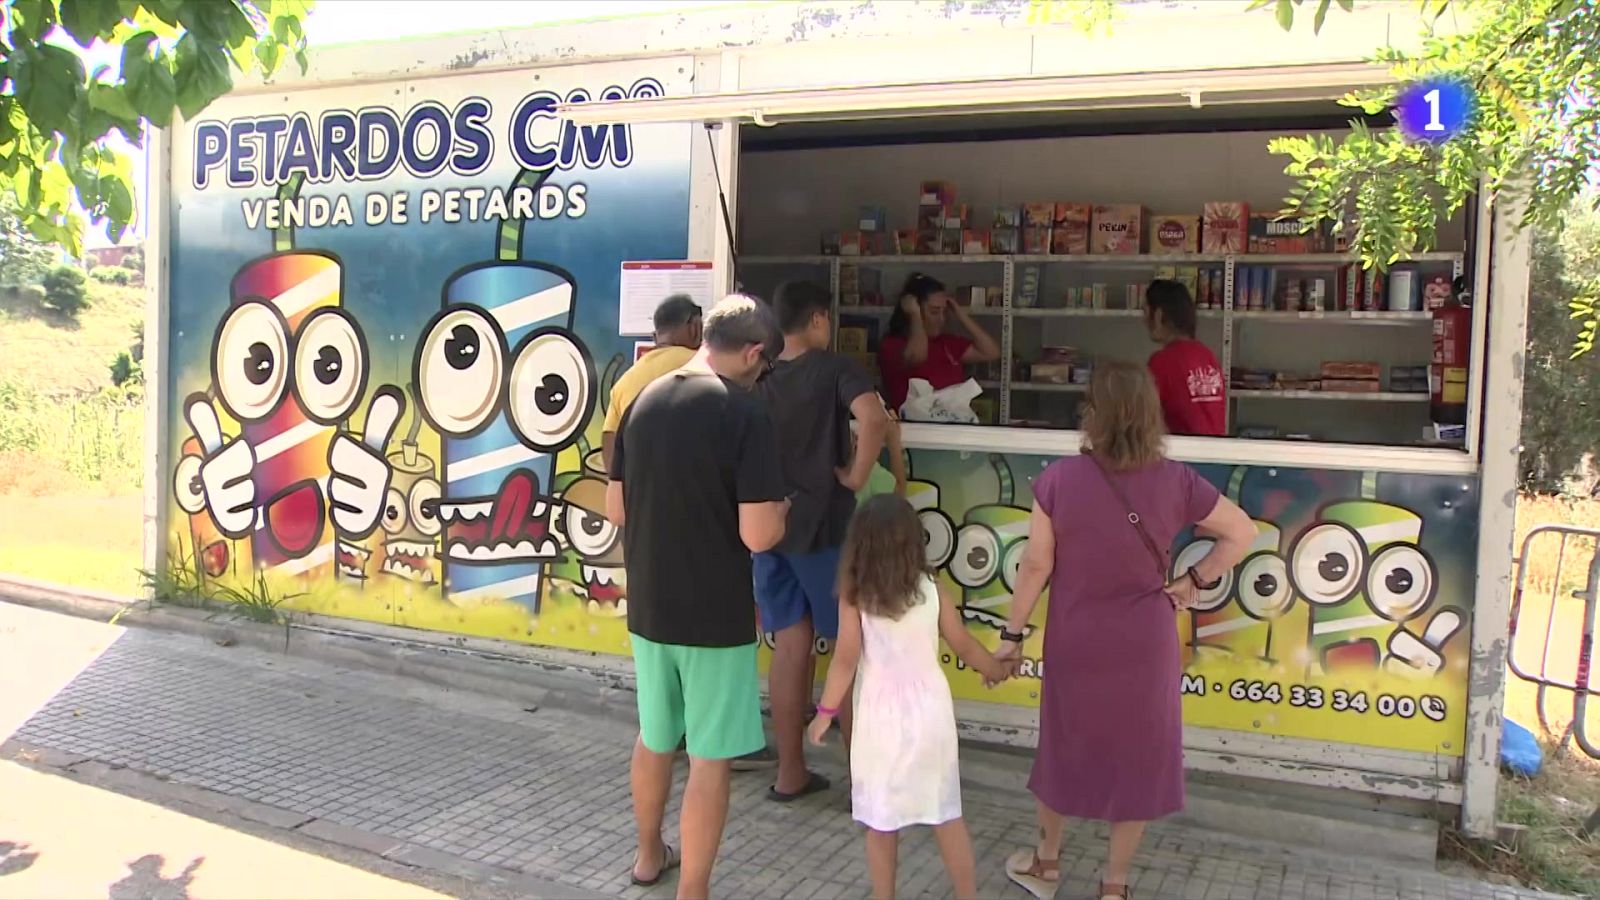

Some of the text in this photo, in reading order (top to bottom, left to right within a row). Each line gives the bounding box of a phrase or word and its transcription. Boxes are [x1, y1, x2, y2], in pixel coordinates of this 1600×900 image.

[193, 98, 496, 189] PETARDOS
[241, 181, 588, 230] VENDA DE PETARDS
[1098, 222, 1127, 232] PEKIN
[1229, 679, 1283, 705] 664
[1290, 685, 1324, 708] 33
[1332, 689, 1369, 713] 34
[1377, 694, 1416, 719] 00
